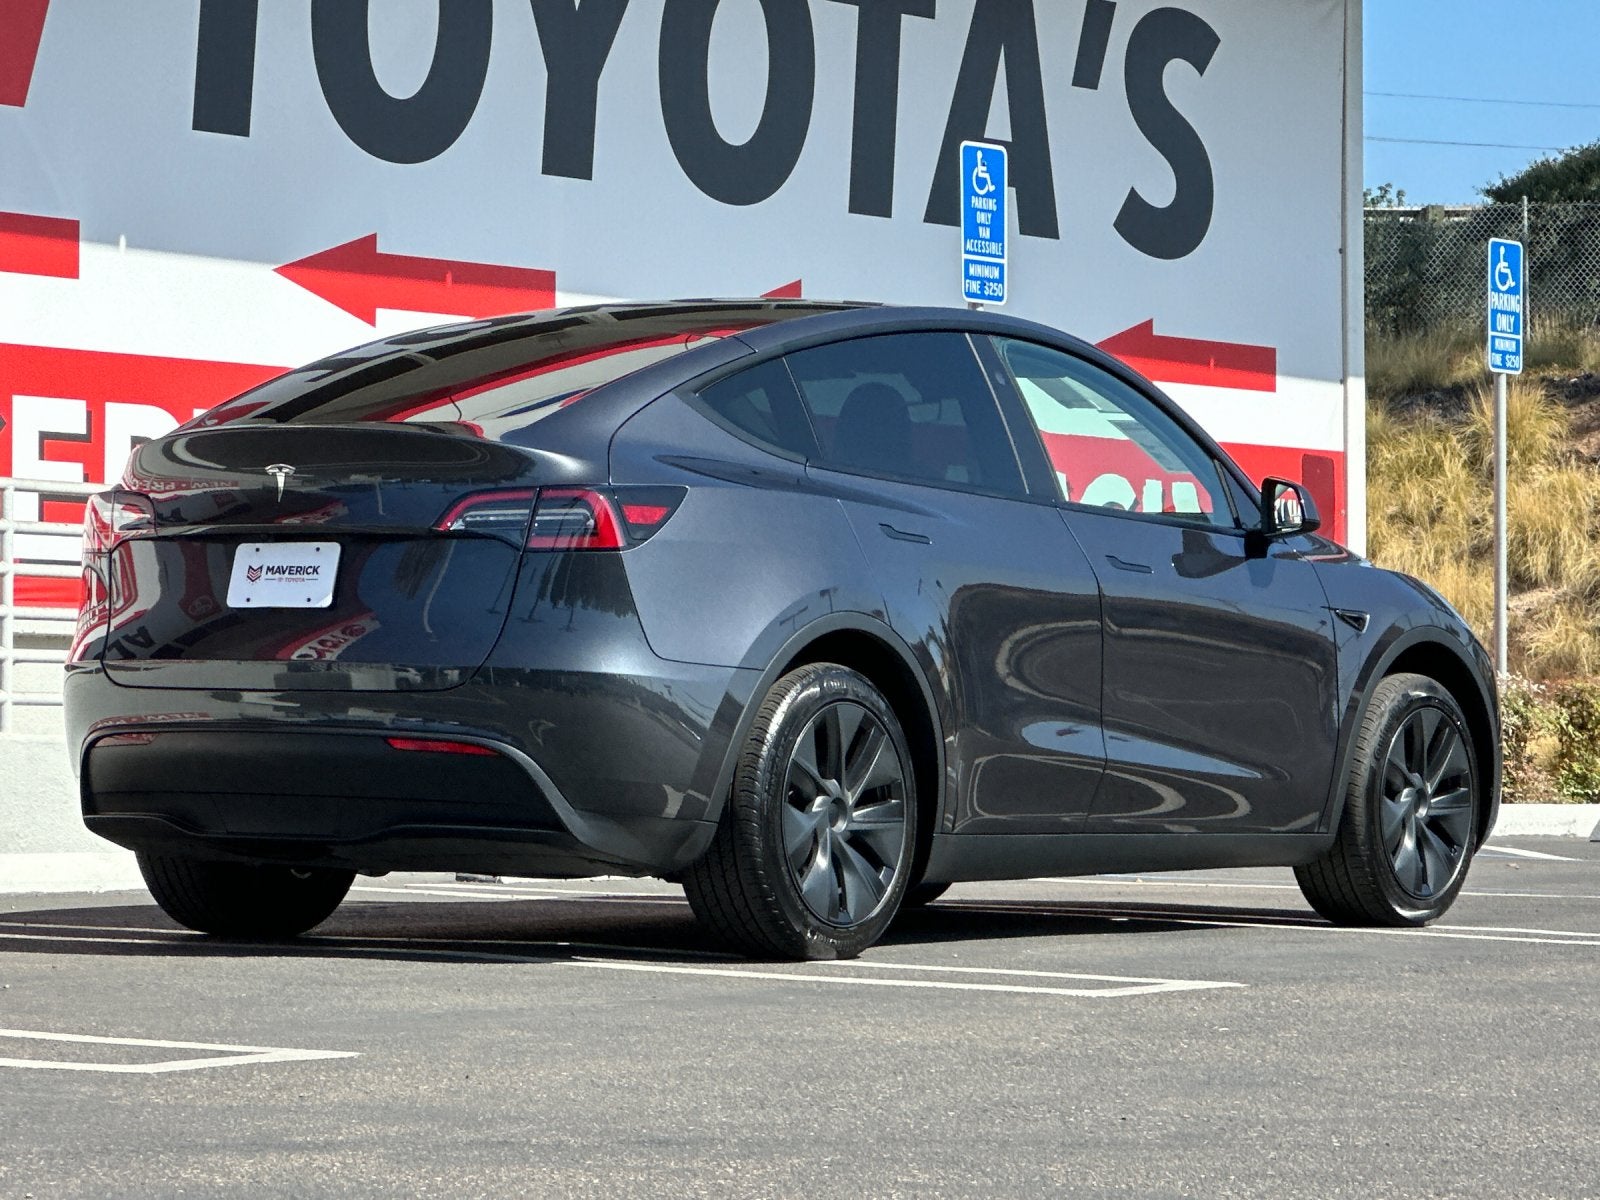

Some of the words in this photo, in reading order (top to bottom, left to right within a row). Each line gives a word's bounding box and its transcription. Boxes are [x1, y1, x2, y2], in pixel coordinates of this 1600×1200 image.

[971, 195, 997, 211] PARKING
[976, 211, 992, 225] ONLY
[978, 226, 991, 240] VAN
[965, 239, 1003, 256] ACCESSIBLE
[968, 263, 1000, 280] MINIMUM
[965, 280, 981, 294] FINE
[983, 281, 1003, 297] $250
[1491, 291, 1520, 313] PARKING
[1496, 313, 1515, 333] ONLY
[265, 565, 321, 576] MAVERICK
